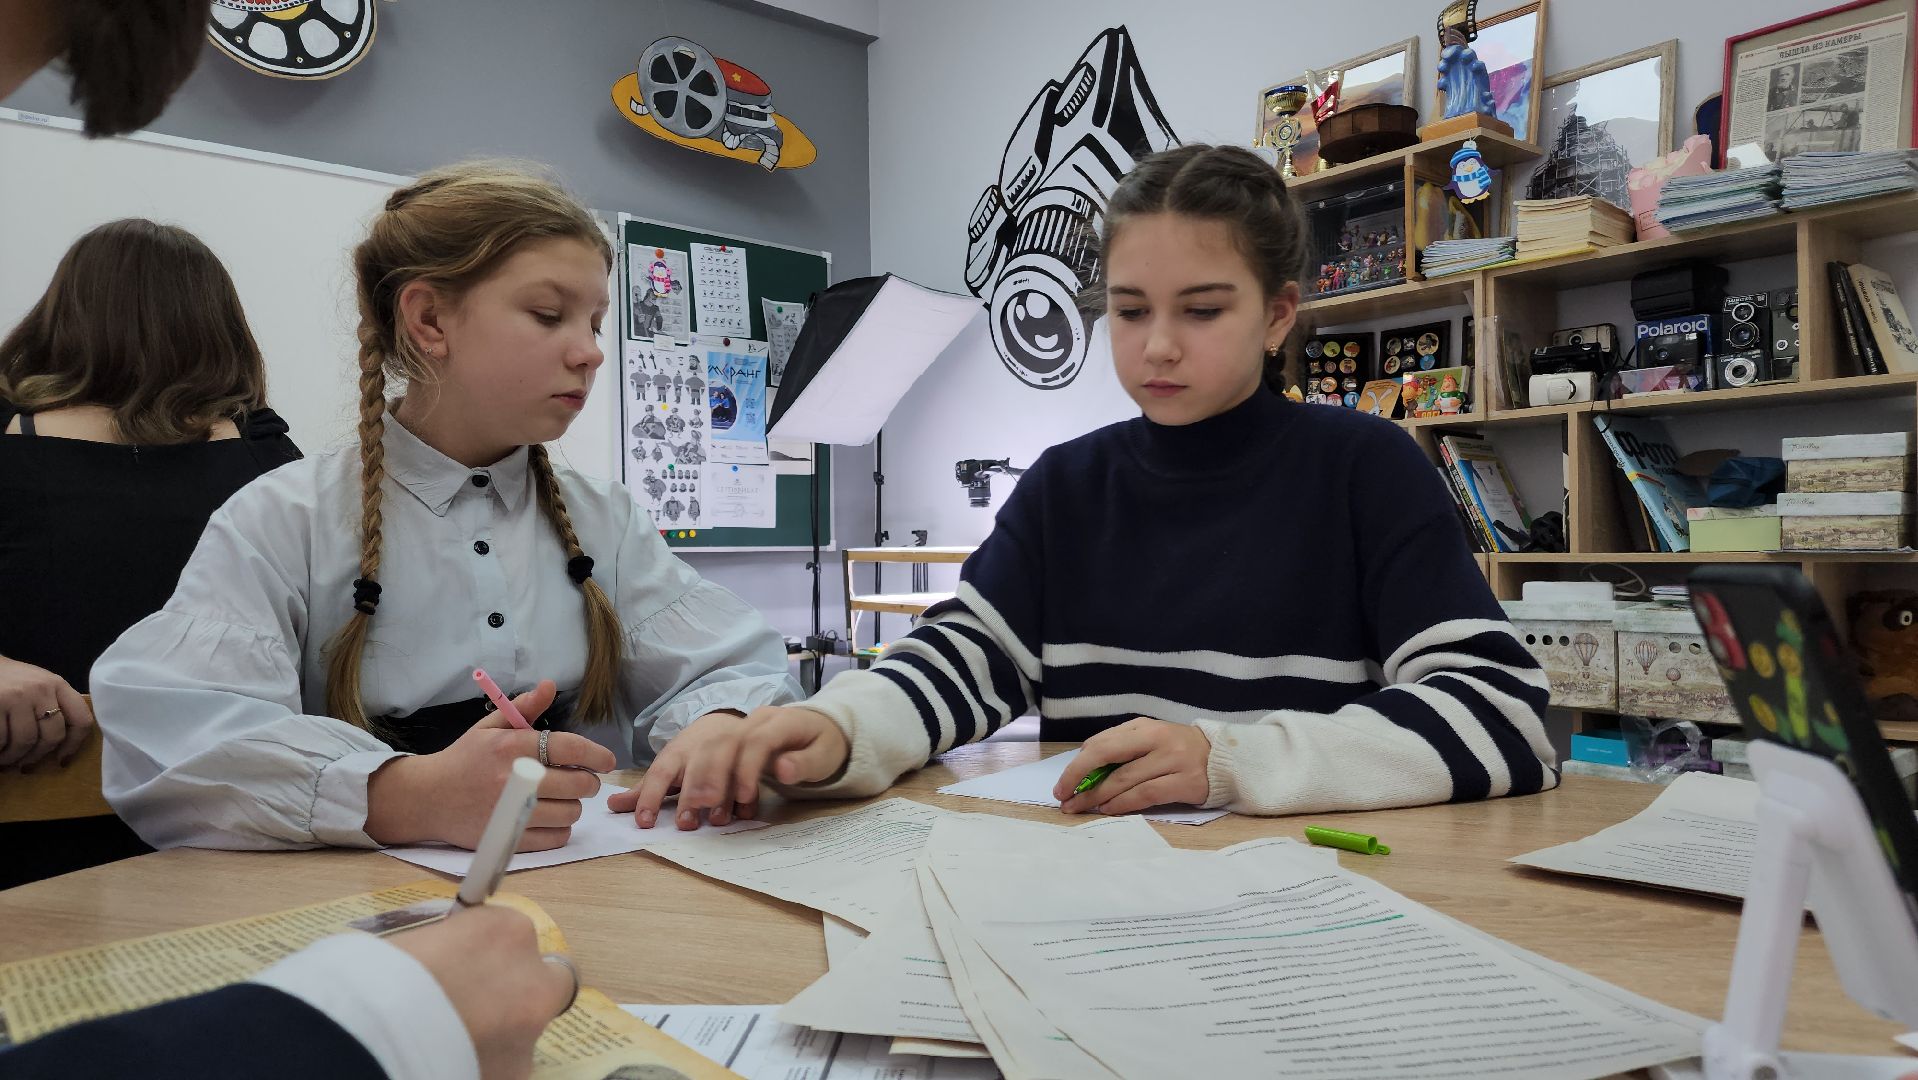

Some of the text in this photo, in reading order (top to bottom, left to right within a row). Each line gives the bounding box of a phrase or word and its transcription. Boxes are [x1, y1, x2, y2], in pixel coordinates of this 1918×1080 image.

[1779, 45, 1811, 59] ВЫШЛА
[1812, 41, 1823, 51] ИЗ
[1824, 33, 1863, 47] КАМЕРЫ
[1637, 317, 1708, 338] Polaroid
